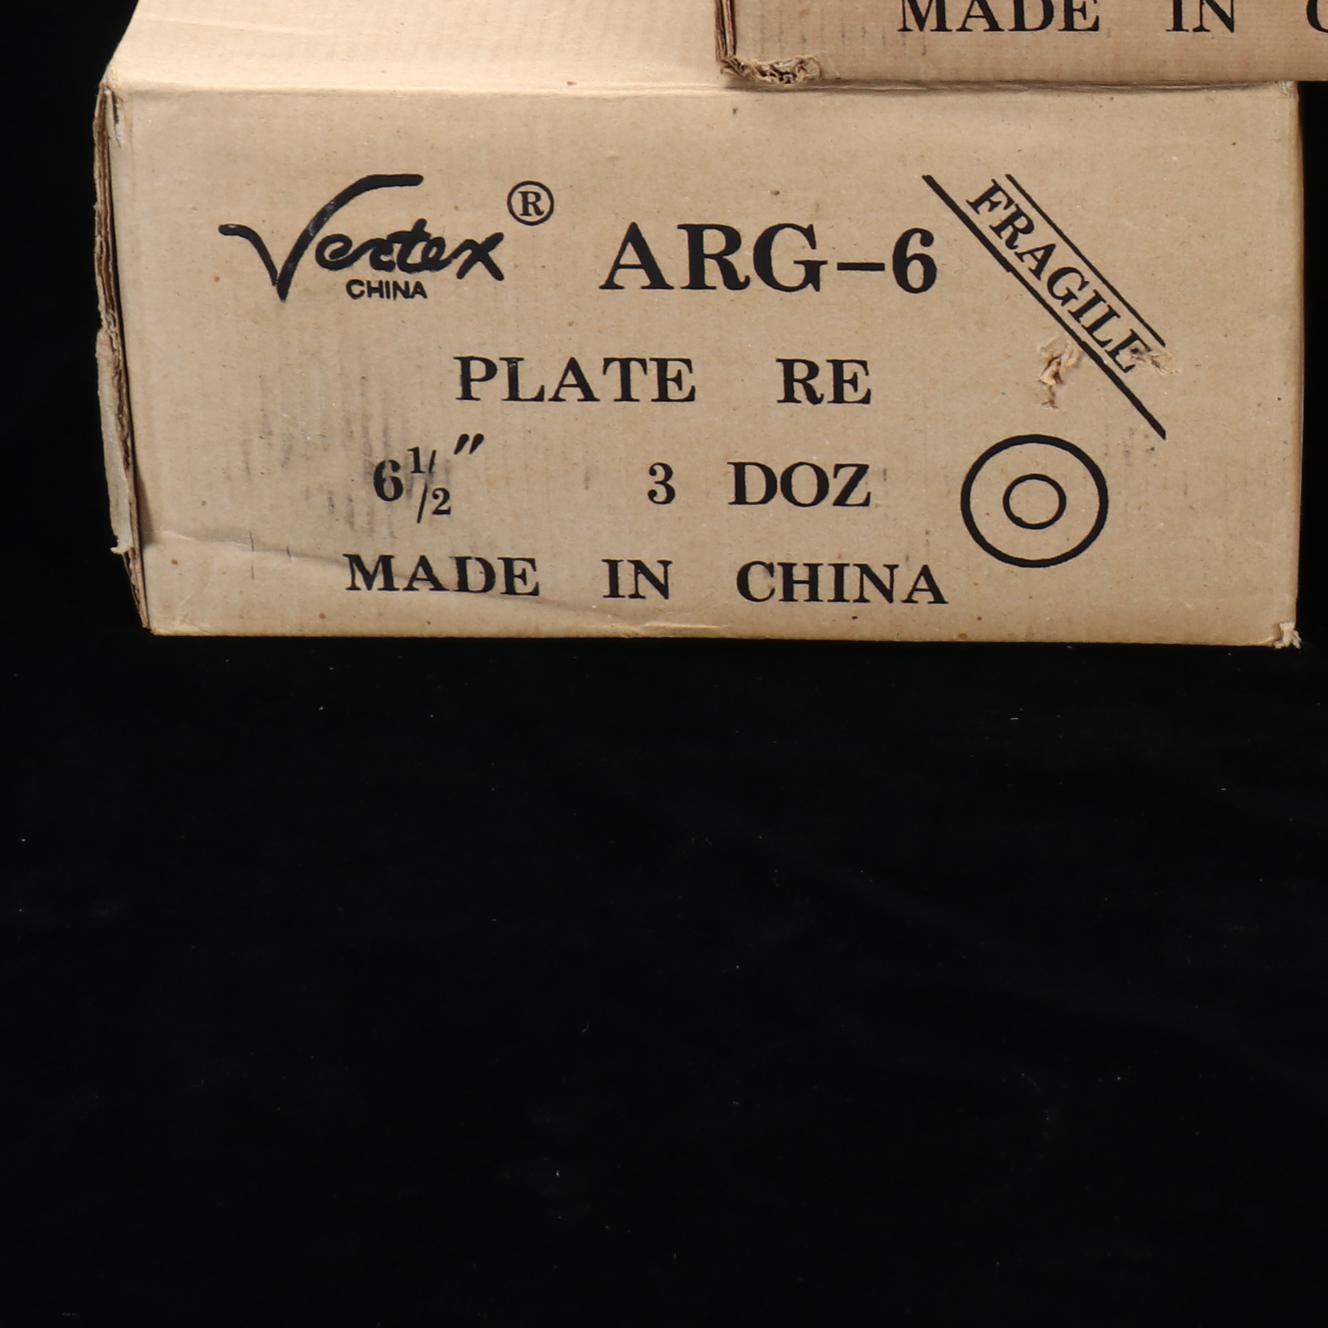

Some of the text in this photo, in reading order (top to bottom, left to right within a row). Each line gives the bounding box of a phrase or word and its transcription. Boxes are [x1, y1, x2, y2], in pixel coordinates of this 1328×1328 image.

[217, 173, 505, 303] Vertex
[598, 221, 938, 295] ARG-6
[345, 278, 428, 301] CHINA
[965, 178, 1153, 374] FRAGILE
[453, 355, 872, 406] PLATE RE
[647, 462, 676, 506] 3
[726, 461, 872, 508] DOZ
[342, 553, 949, 605] MADE IN CHINA
